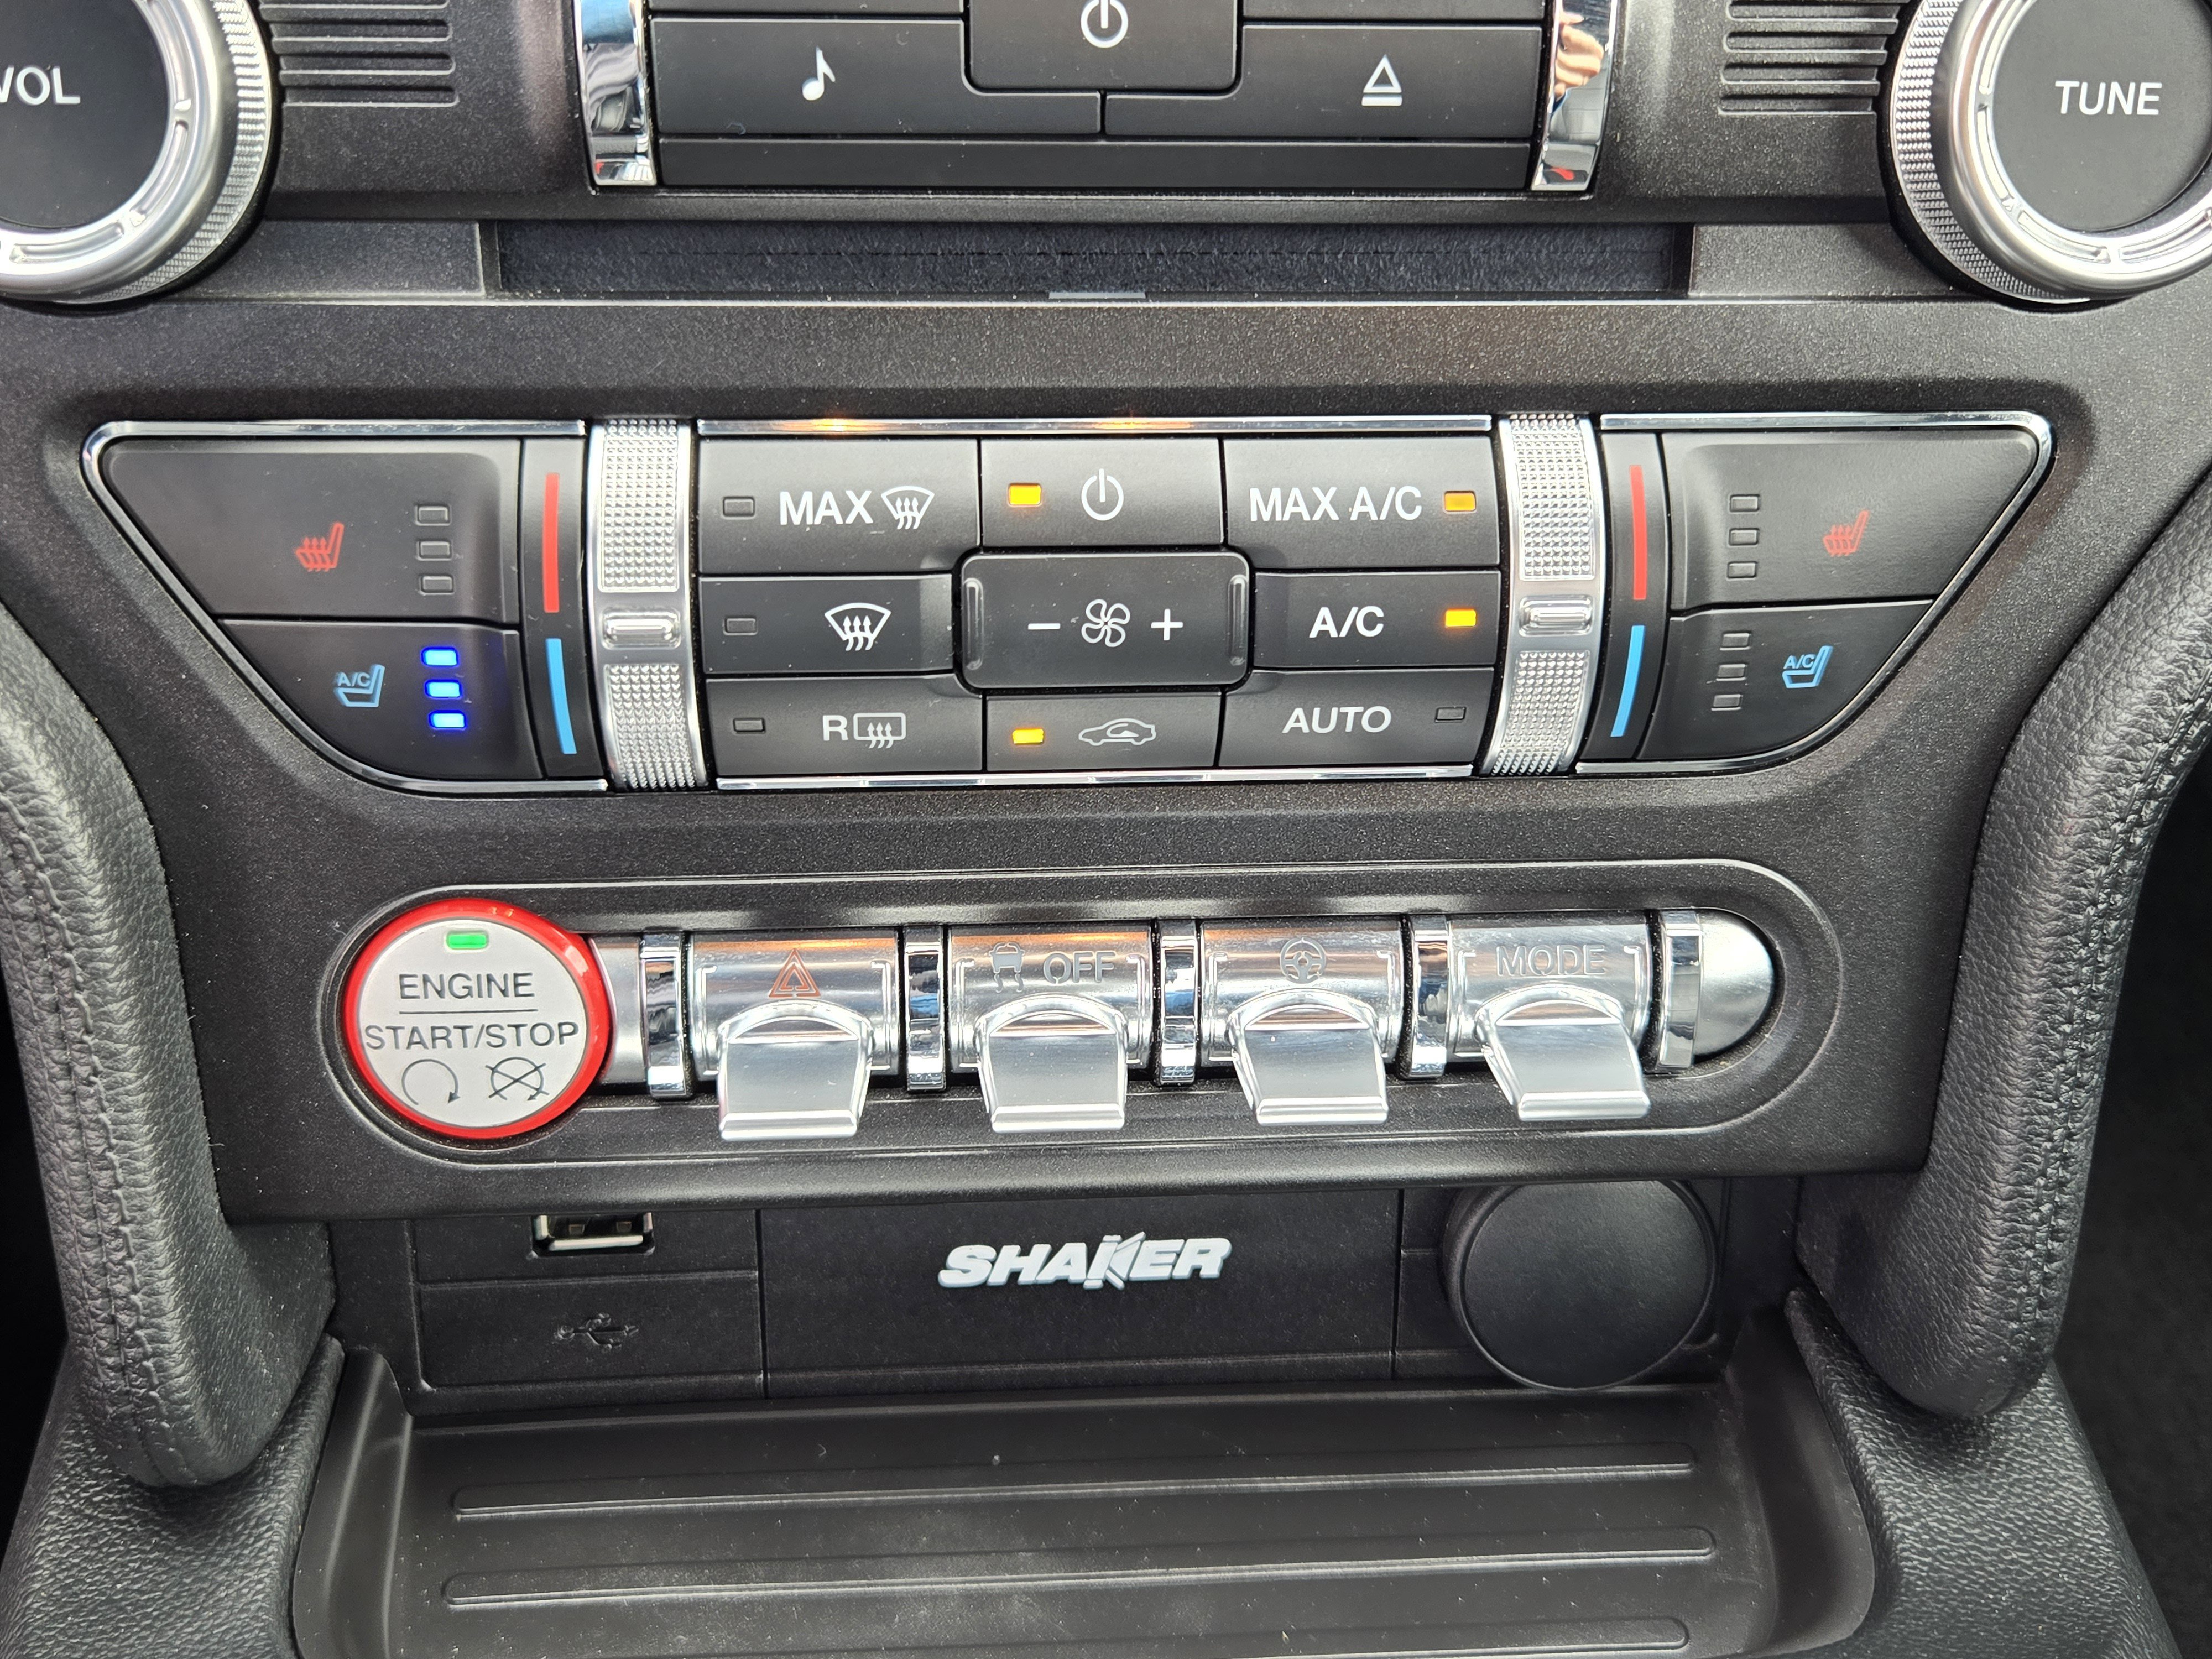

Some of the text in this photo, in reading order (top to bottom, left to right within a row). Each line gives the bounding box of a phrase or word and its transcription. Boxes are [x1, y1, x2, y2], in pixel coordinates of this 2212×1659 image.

[2054, 81, 2162, 116] TUNE
[780, 490, 873, 525] MAX
[1249, 485, 1422, 521] MAX A/C
[1309, 606, 1384, 639] A/C
[1783, 654, 1815, 670] A/C
[336, 671, 371, 687] A/C
[822, 716, 849, 741] R
[1282, 706, 1392, 733] AUTO
[1042, 951, 1116, 984] OFF
[1496, 944, 1606, 976] MODE
[399, 972, 535, 1000] ENGINE
[364, 1021, 579, 1050] START/STOP
[938, 1232, 1232, 1289] SHAKER
